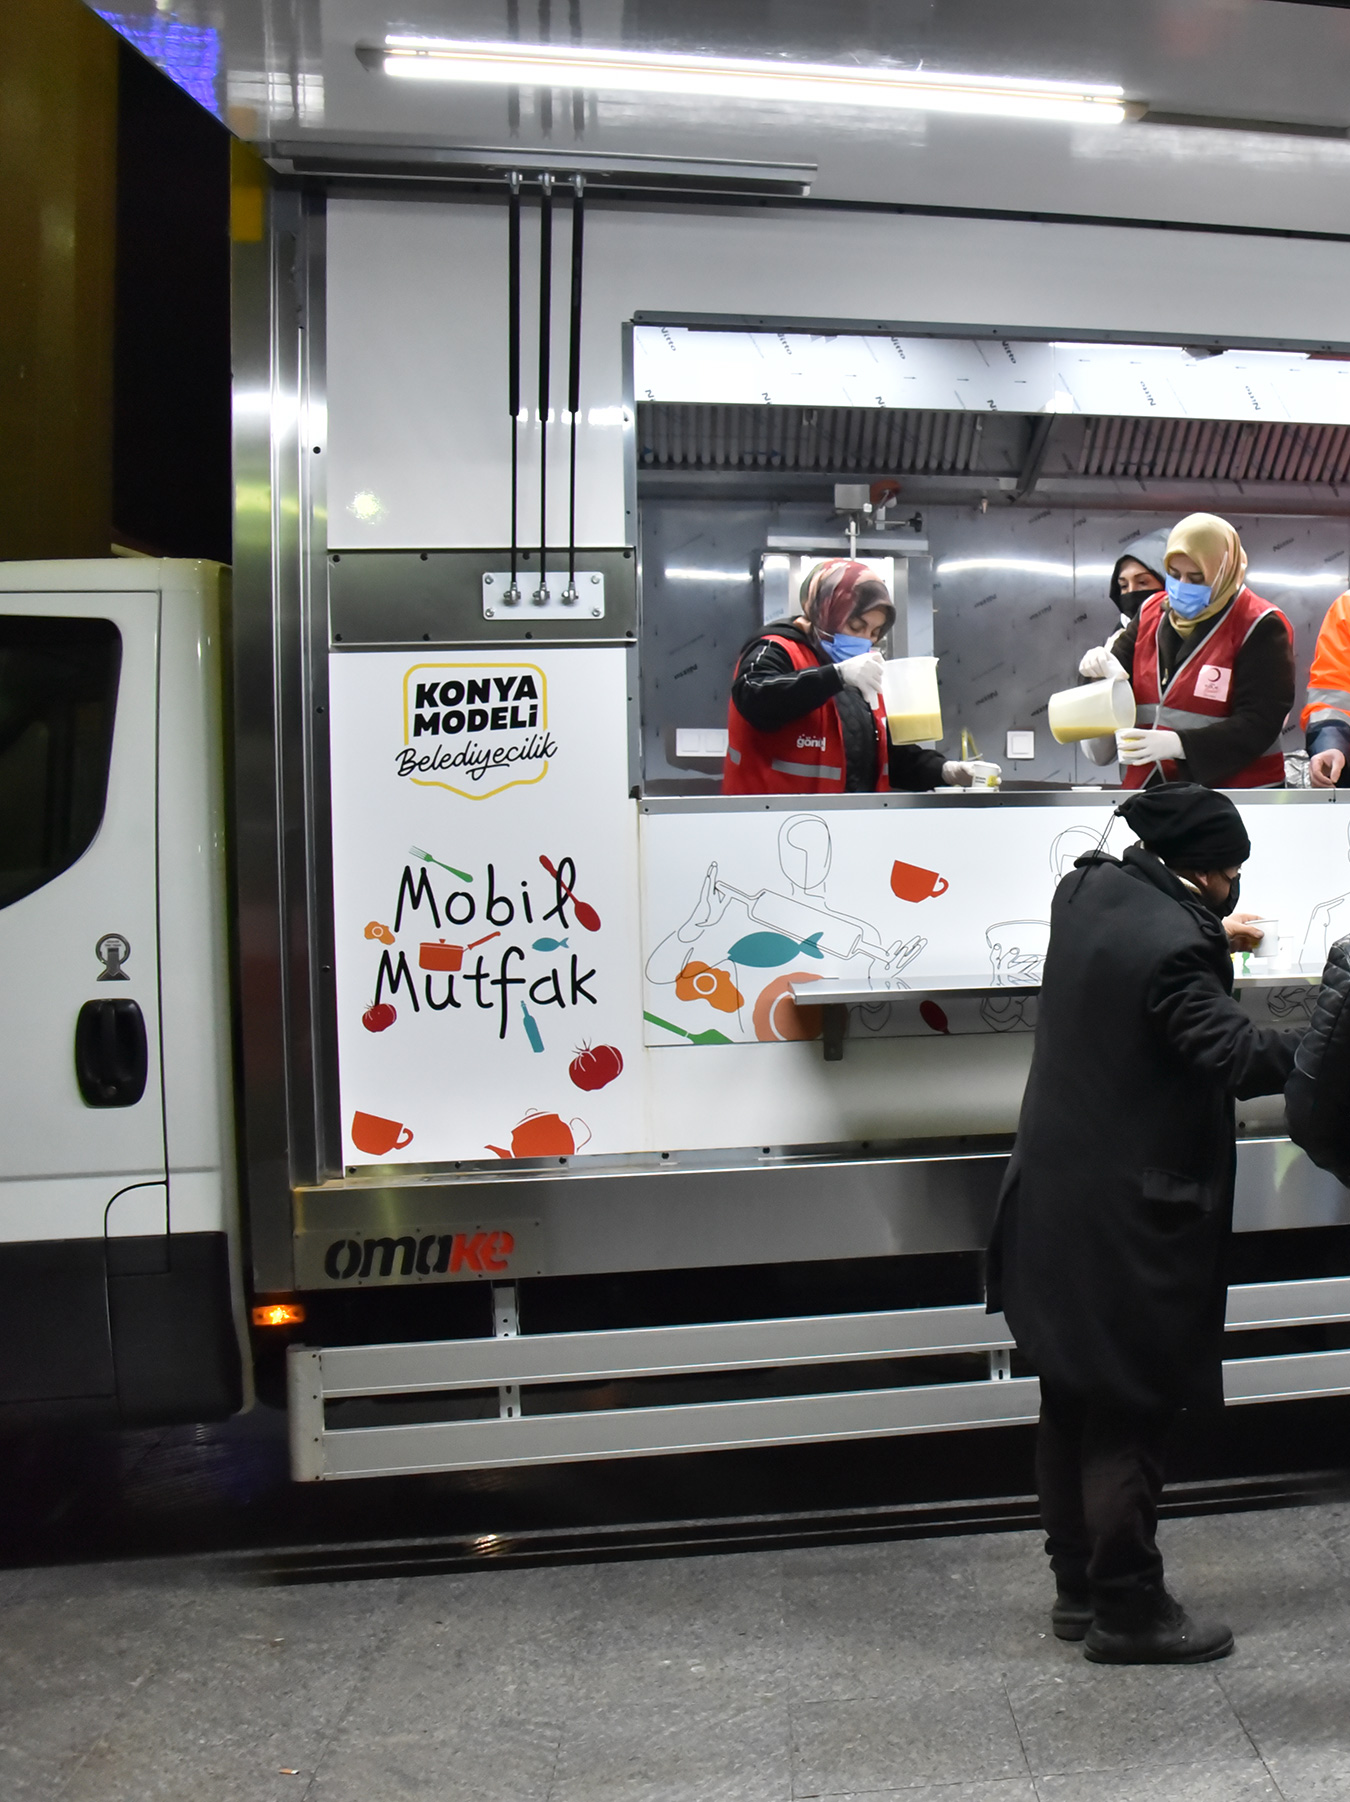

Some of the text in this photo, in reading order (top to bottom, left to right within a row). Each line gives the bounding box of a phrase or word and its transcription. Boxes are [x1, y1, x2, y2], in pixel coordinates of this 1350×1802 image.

[415, 675, 538, 709] KONYA
[395, 732, 558, 781] Belediyecilik
[394, 856, 577, 932] Mobil
[375, 946, 597, 1039] Mutfak
